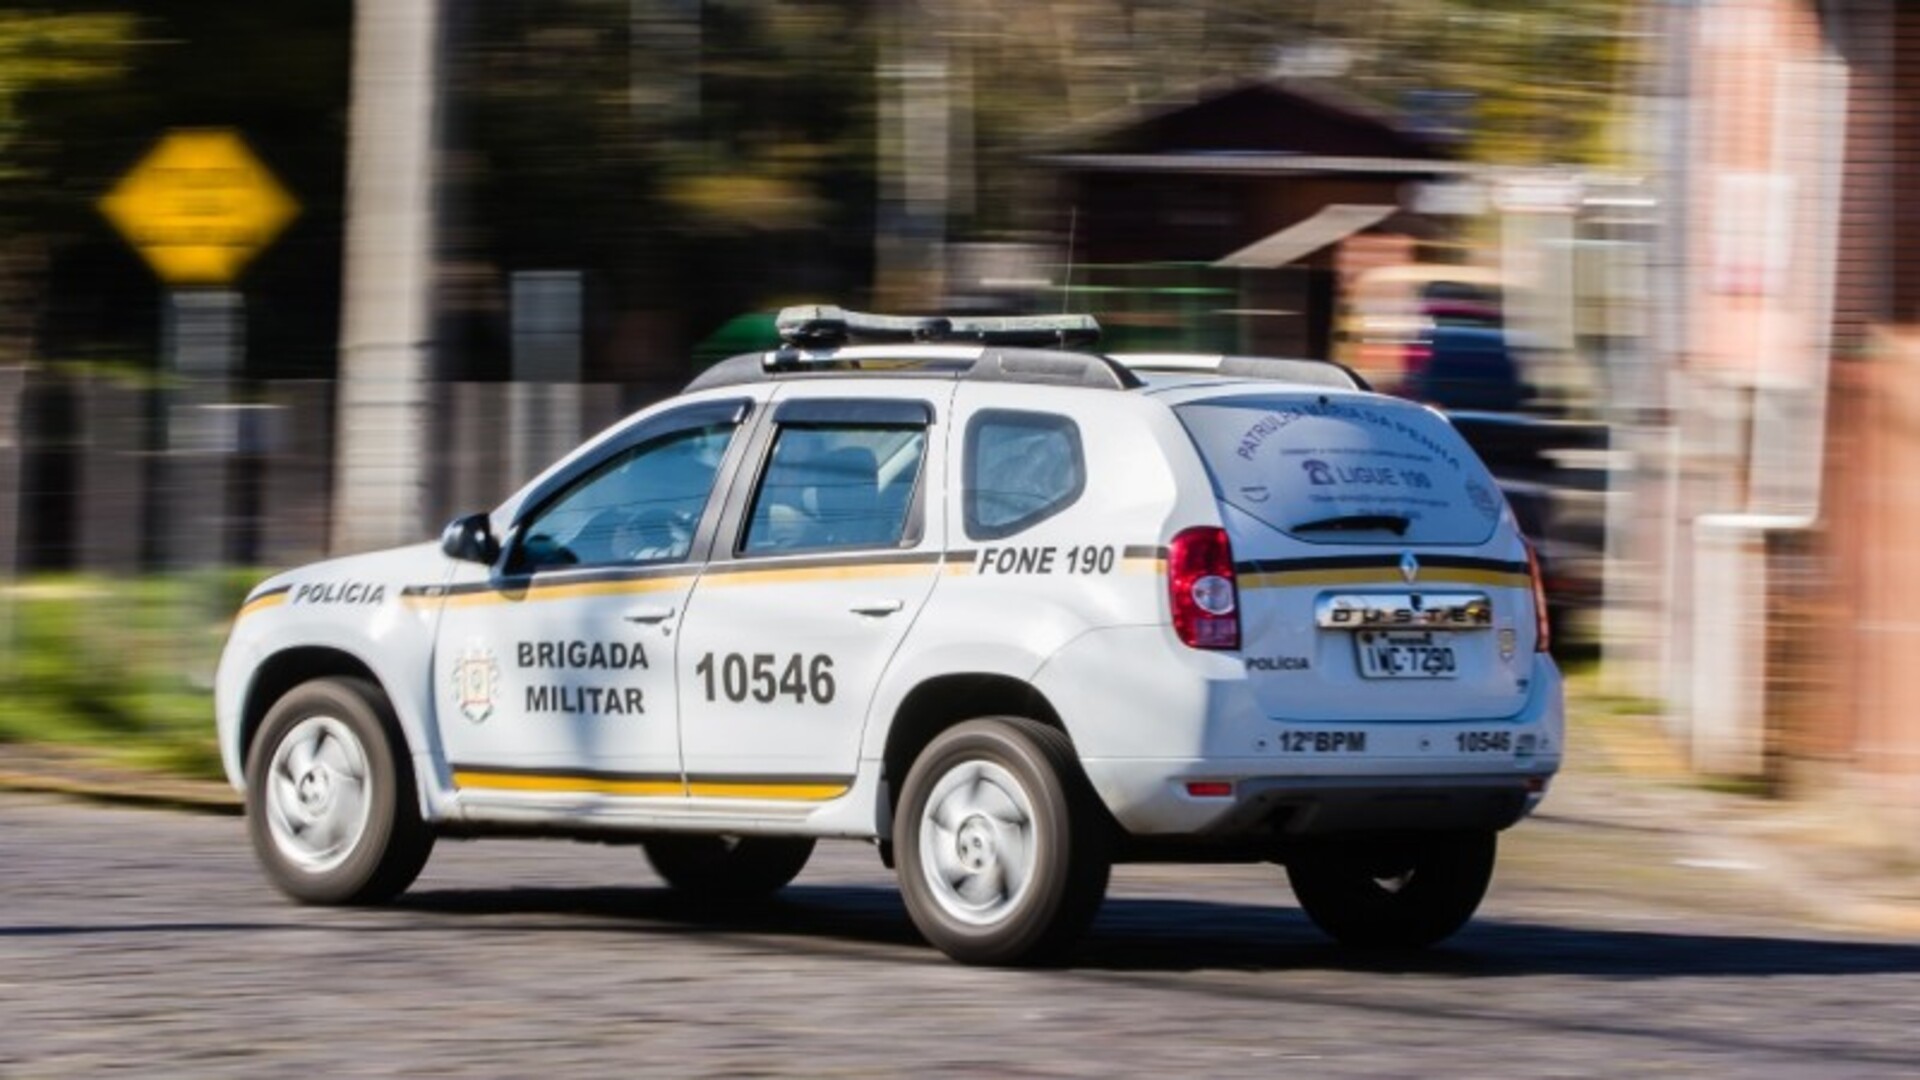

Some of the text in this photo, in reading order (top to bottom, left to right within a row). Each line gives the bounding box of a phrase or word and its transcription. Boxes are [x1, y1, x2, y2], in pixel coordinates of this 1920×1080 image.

[1337, 466, 1398, 486] LIGUE
[979, 545, 1115, 574] FONE 190
[294, 580, 386, 605] POLÍCIA
[1331, 606, 1492, 623] DUSTER
[517, 641, 649, 669] BRIGADA
[696, 652, 836, 705] 10546
[525, 687, 645, 715] MILITAR
[1456, 731, 1511, 752] 10546
